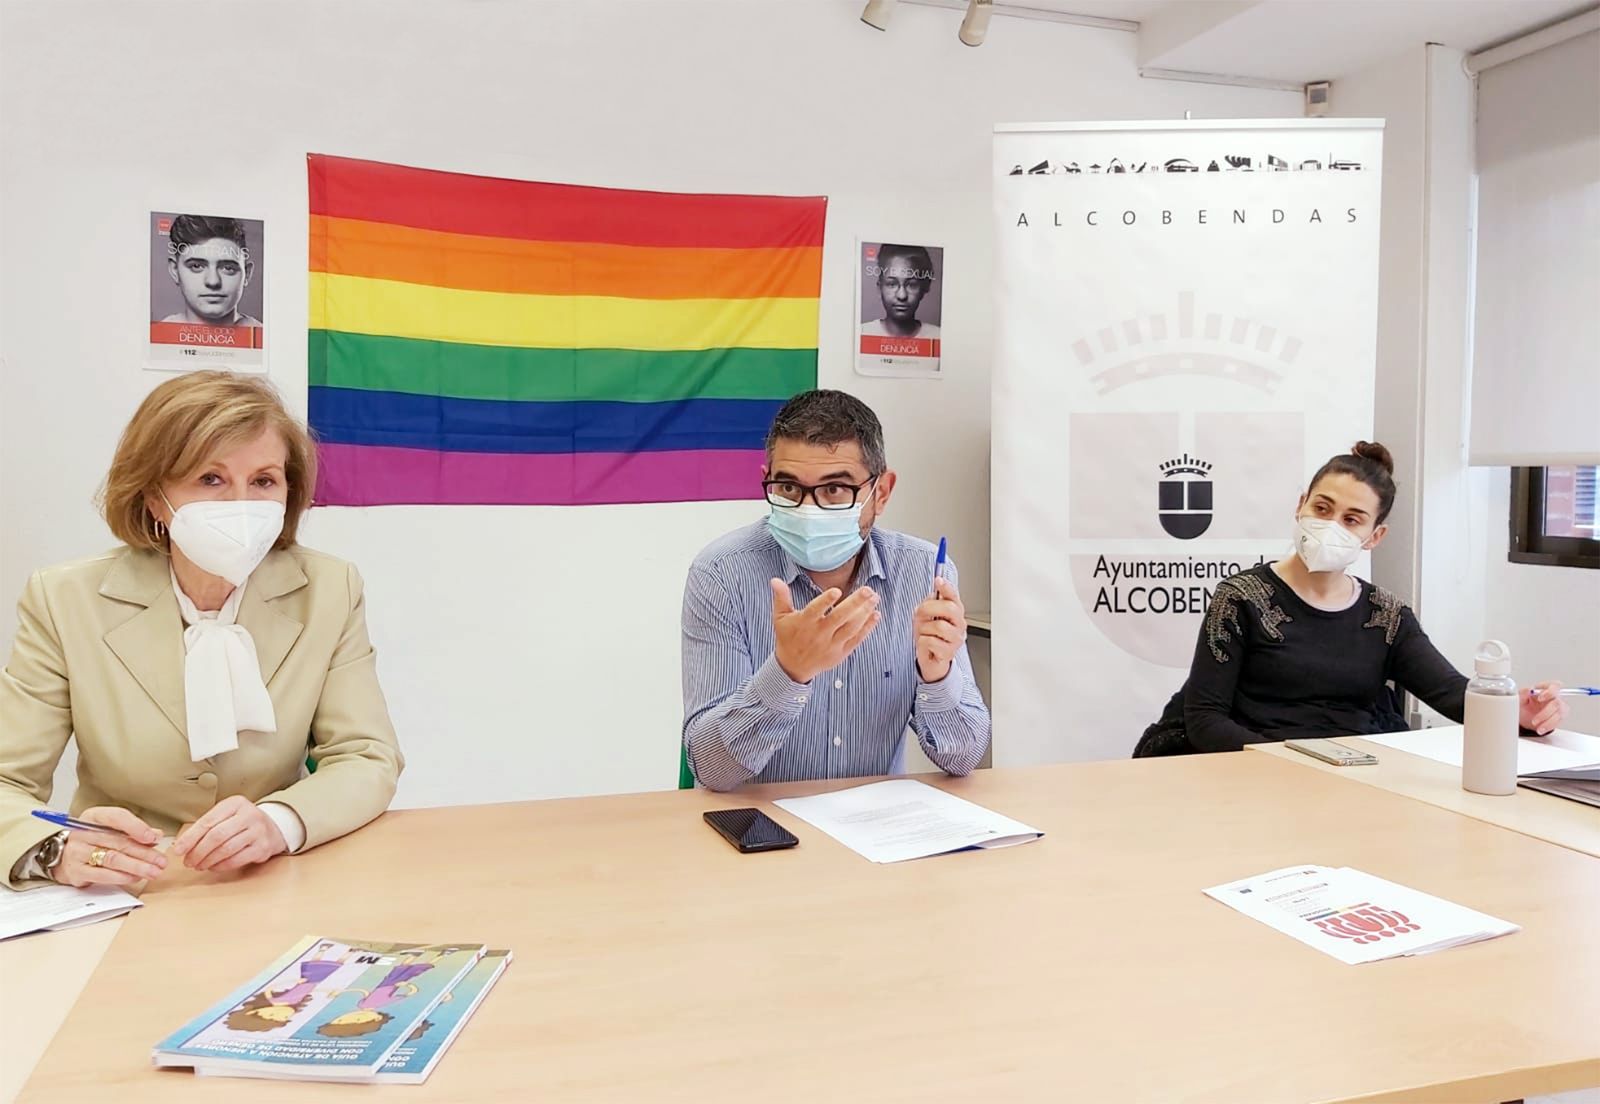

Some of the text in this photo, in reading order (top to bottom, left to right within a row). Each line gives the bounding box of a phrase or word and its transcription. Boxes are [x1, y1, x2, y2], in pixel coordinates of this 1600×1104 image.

[1016, 208, 1357, 227] ALCOBENDAS
[865, 265, 888, 277] SOY
[179, 332, 235, 345] DENUNCIA
[880, 344, 920, 354] DENUNCIA
[1093, 554, 1241, 586] Ayuntamiento
[1093, 587, 1216, 613] ALCOBEN
